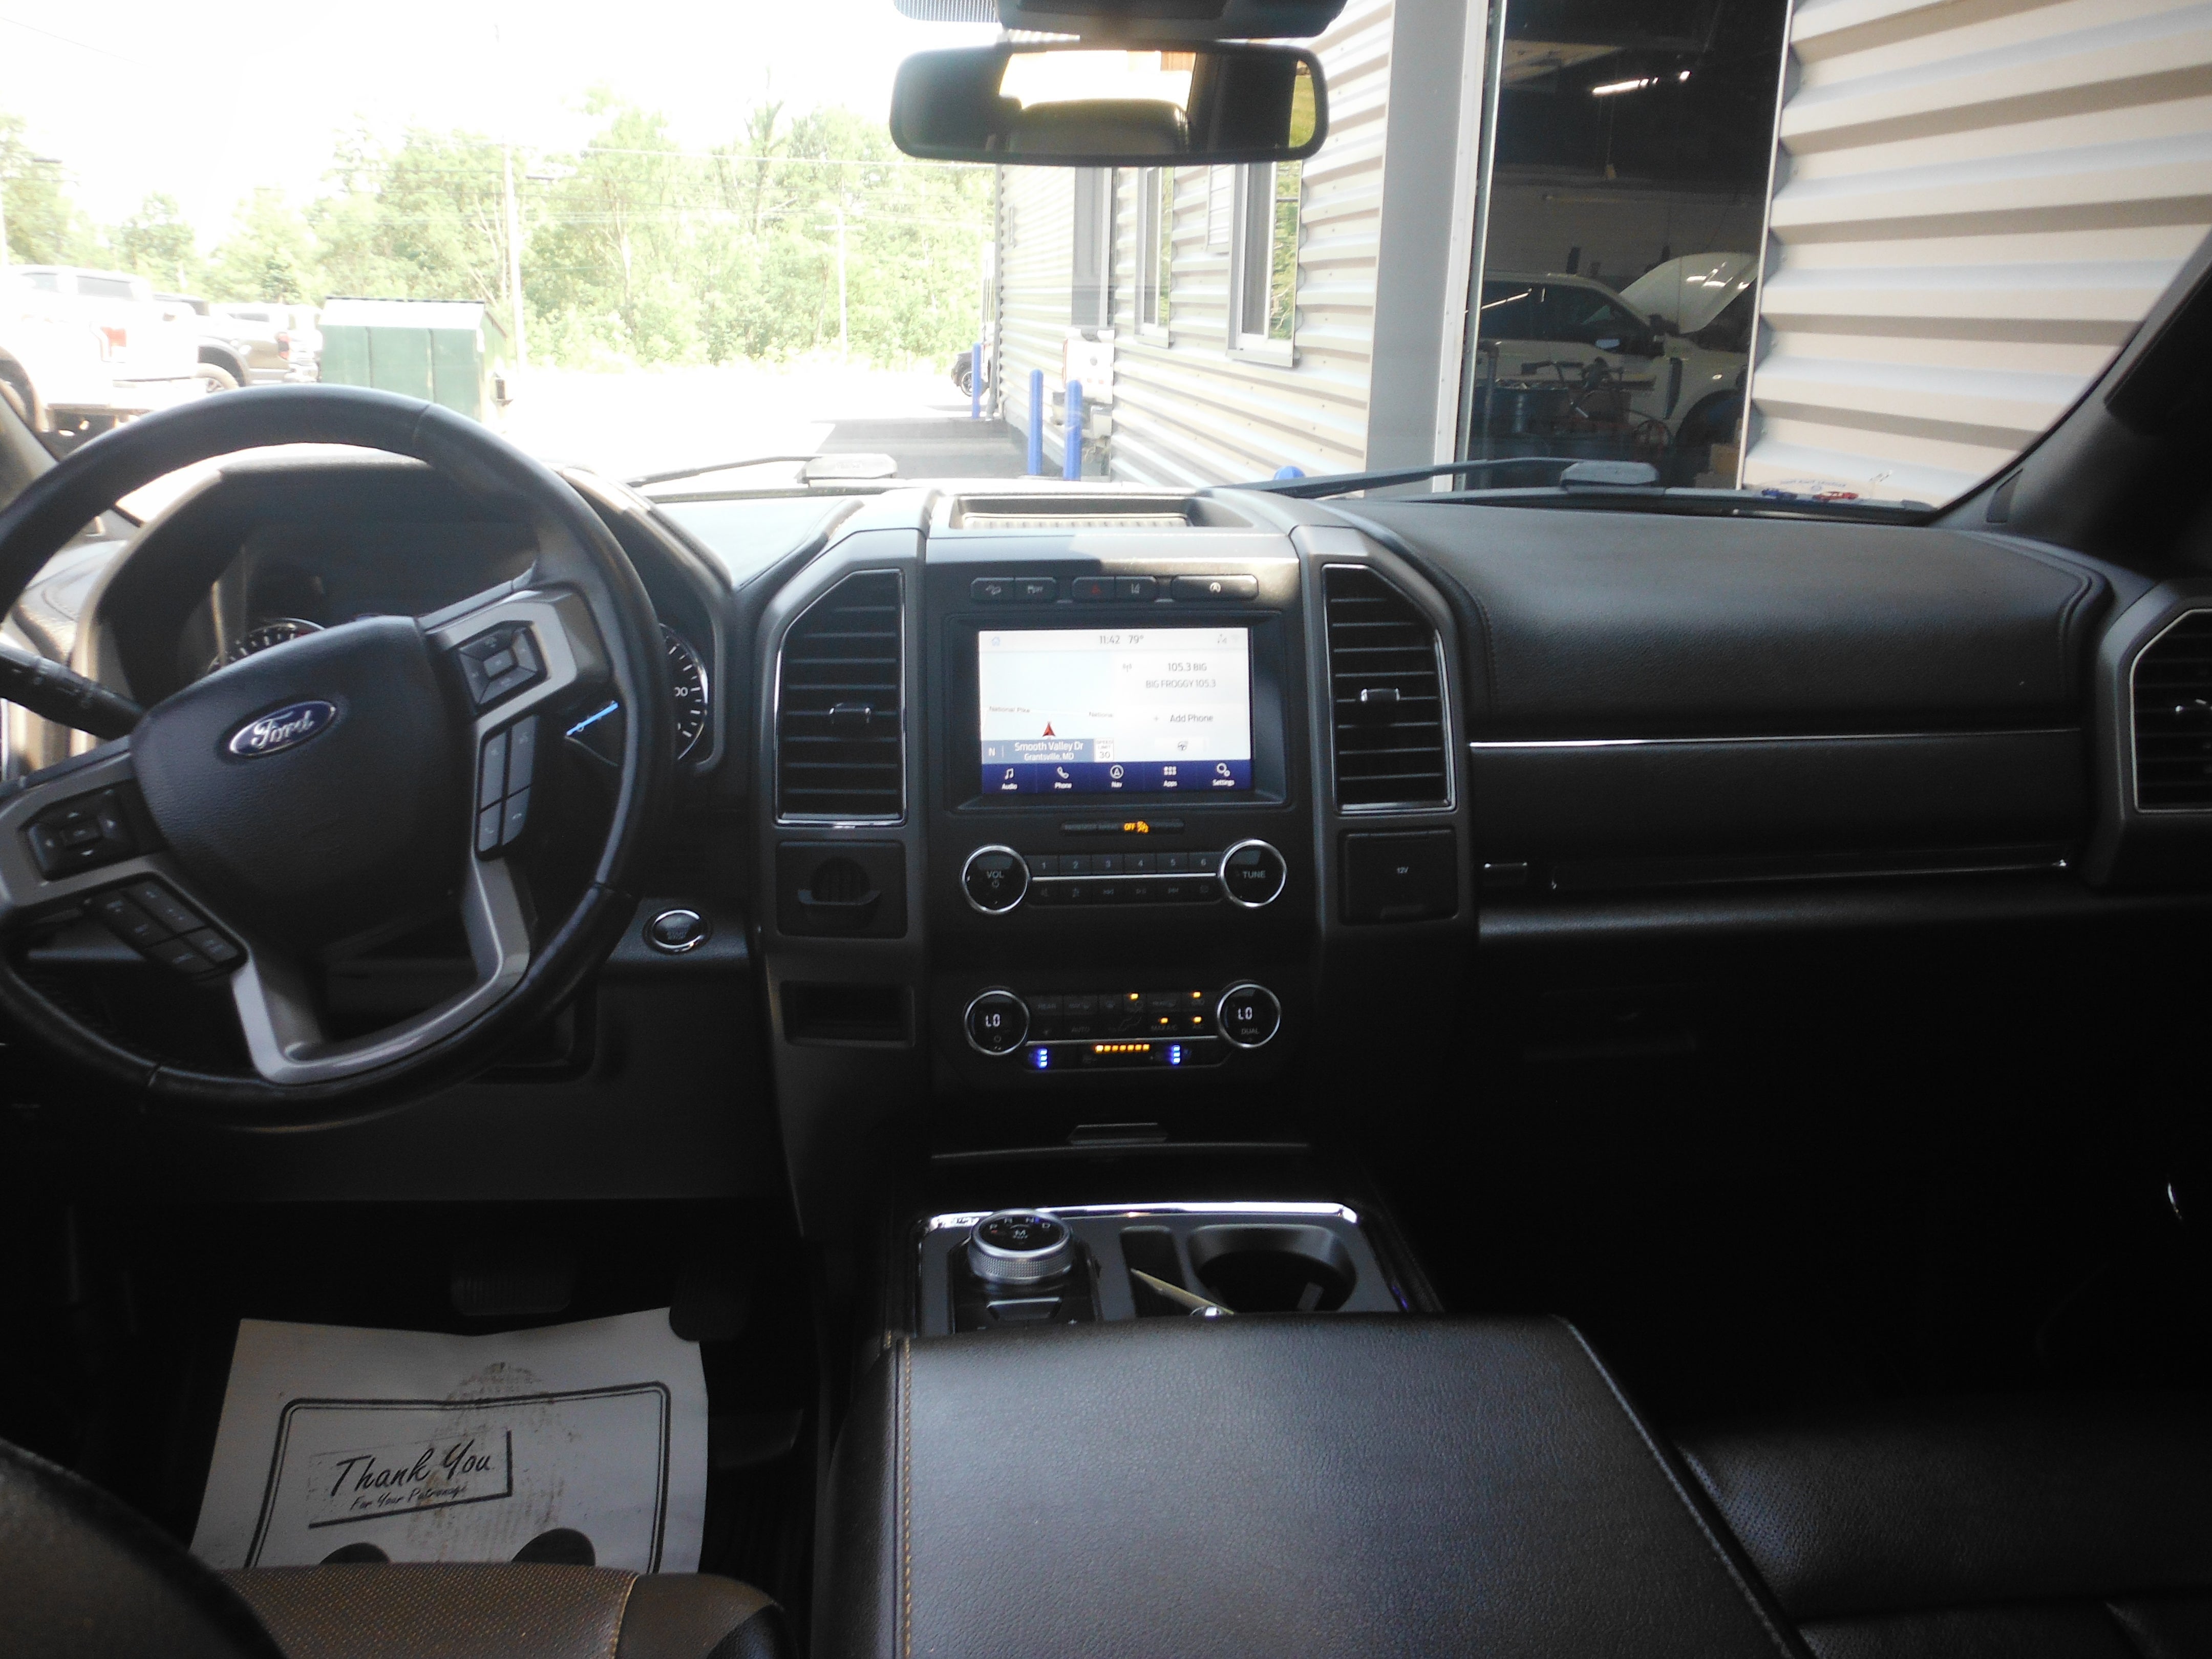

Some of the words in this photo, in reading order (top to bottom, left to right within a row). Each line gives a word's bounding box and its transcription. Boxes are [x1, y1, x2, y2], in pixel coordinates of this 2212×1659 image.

[1099, 635, 1121, 645] 11:42
[1128, 634, 1144, 644] 79°
[1168, 662, 1191, 672] 105.3
[1193, 662, 1207, 672] BIG
[1145, 679, 1159, 689] BIG
[1161, 679, 1194, 688] FROGGY
[1196, 678, 1217, 688] 105.3
[1169, 713, 1186, 722] Add
[1187, 713, 1214, 722] Phone
[251, 709, 315, 749] Ford
[1014, 741, 1047, 752] Smooth
[1048, 741, 1074, 752] Valley
[1074, 741, 1083, 751] Dr
[988, 747, 996, 757] N
[1024, 753, 1061, 761] Grantsville,
[1062, 752, 1074, 760] MD
[1099, 751, 1111, 759] 30
[1163, 780, 1178, 789] Apps
[1212, 779, 1235, 787] Settings
[1123, 822, 1136, 831] OFF
[1073, 861, 1079, 869] 2
[1105, 860, 1112, 868] 3
[1137, 859, 1144, 867] 4
[1170, 858, 1176, 867] 5
[1200, 858, 1207, 866] 6
[986, 870, 1005, 879] VOL
[1242, 869, 1266, 879] TUNE
[331, 1448, 436, 1497] Thank
[443, 1438, 492, 1480] You
[349, 1495, 372, 1512] For
[377, 1492, 404, 1508] Your
